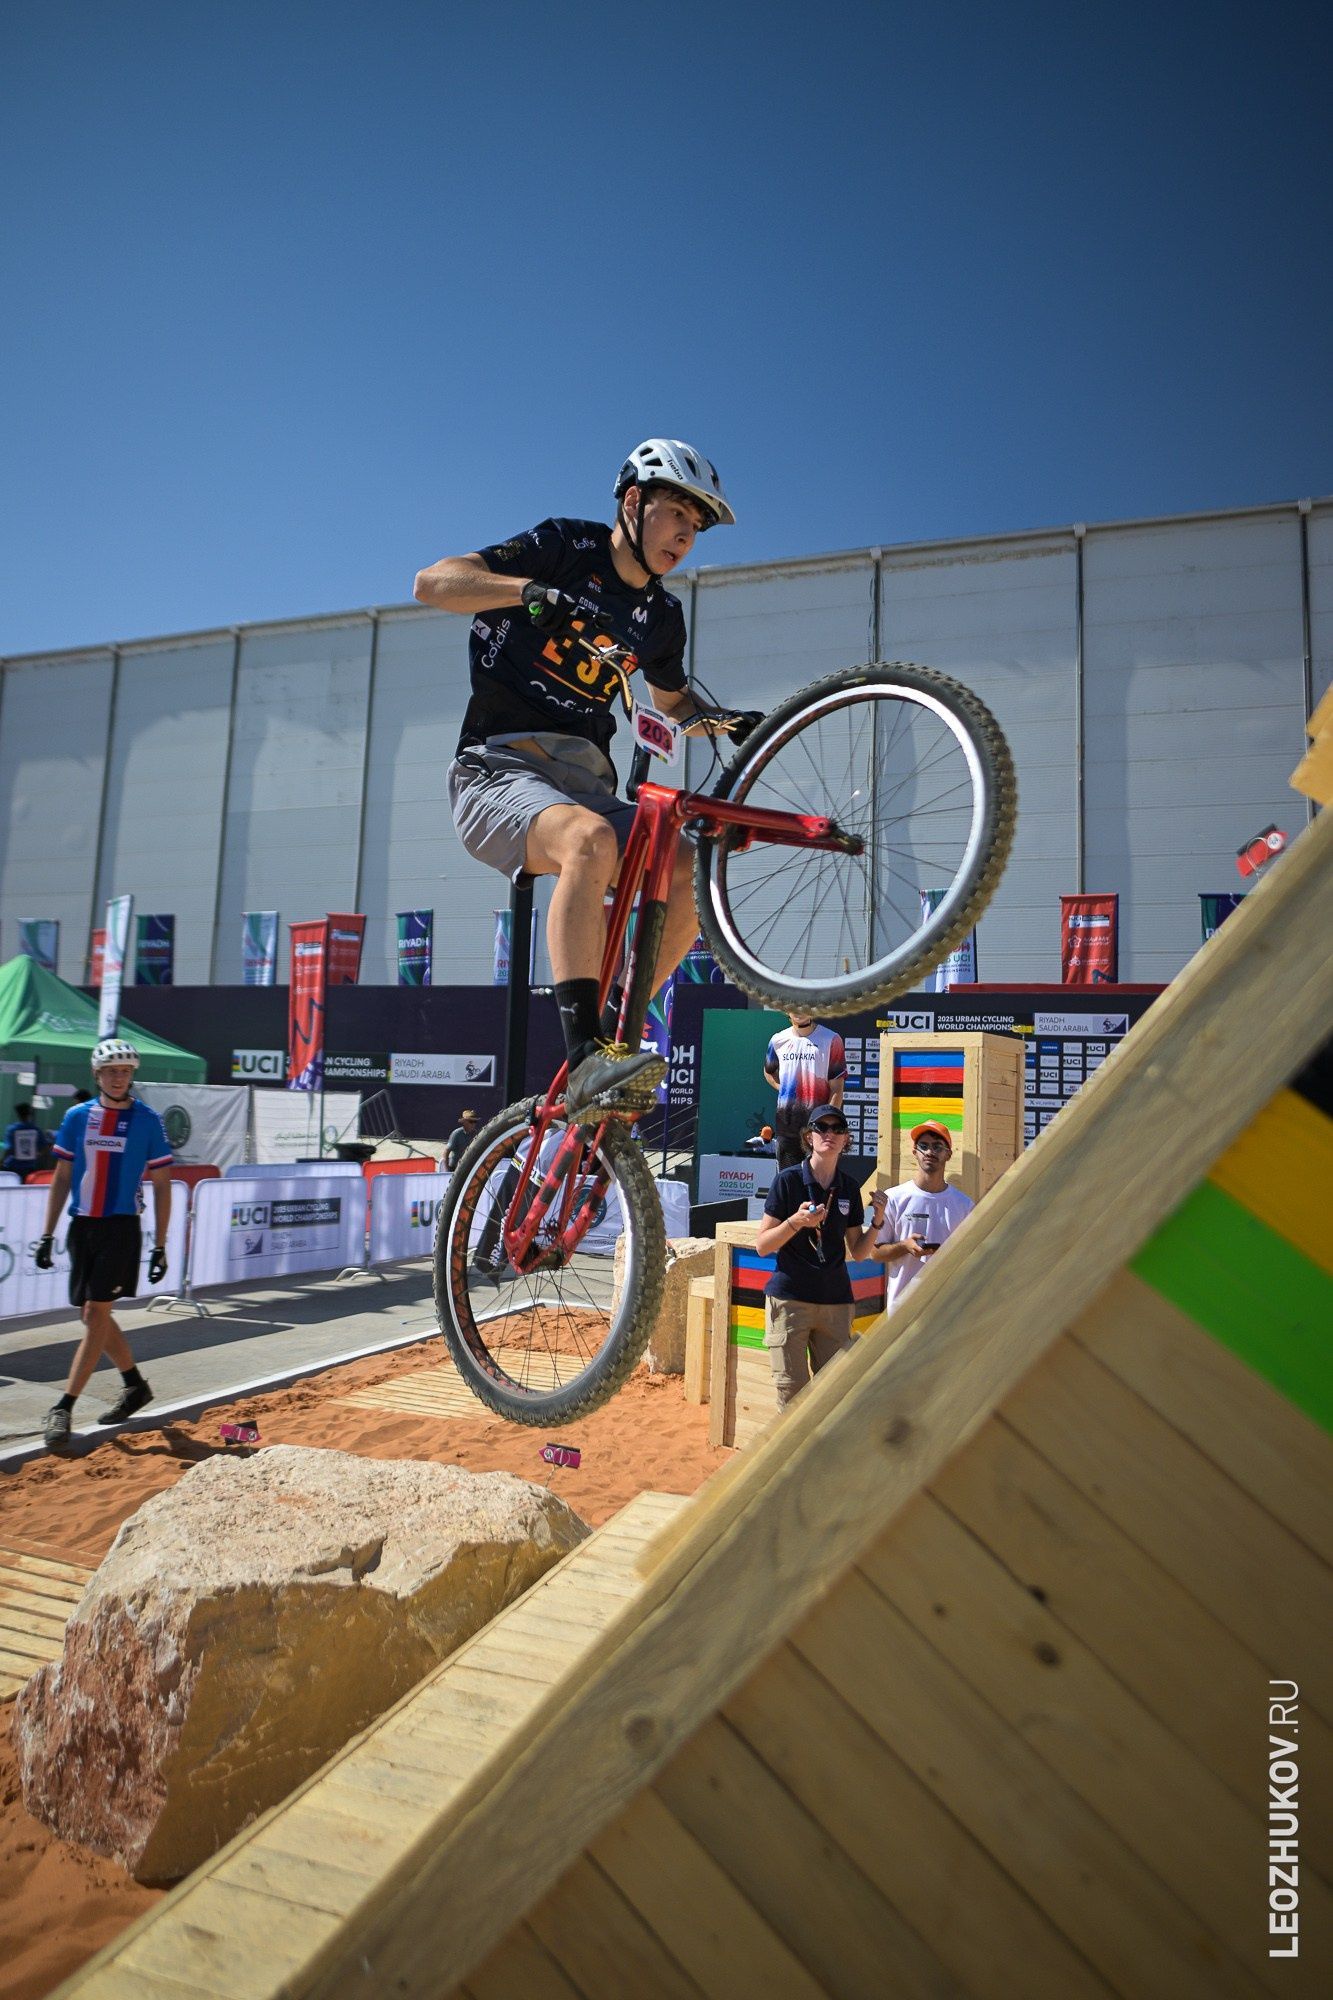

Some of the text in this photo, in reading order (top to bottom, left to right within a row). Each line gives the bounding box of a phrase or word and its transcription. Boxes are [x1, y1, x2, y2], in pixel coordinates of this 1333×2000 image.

[481, 618, 511, 669] Cofidis
[399, 937, 429, 948] RIYADH
[954, 954, 970, 962] UCI
[895, 1015, 930, 1029] UCI
[1039, 1016, 1065, 1024] RIYADH
[1063, 1025, 1089, 1033] ARABIA
[782, 1052, 816, 1061] SLOVAKIA
[241, 1055, 279, 1073] UCI
[334, 1057, 371, 1066] CYCLING
[394, 1058, 424, 1067] RIYADH
[394, 1070, 451, 1079] SAUDI ARABIA
[719, 1171, 754, 1181] RIYADH
[719, 1180, 738, 1188] 2025
[238, 1206, 268, 1225] UCI
[306, 1203, 329, 1211] CYCLING
